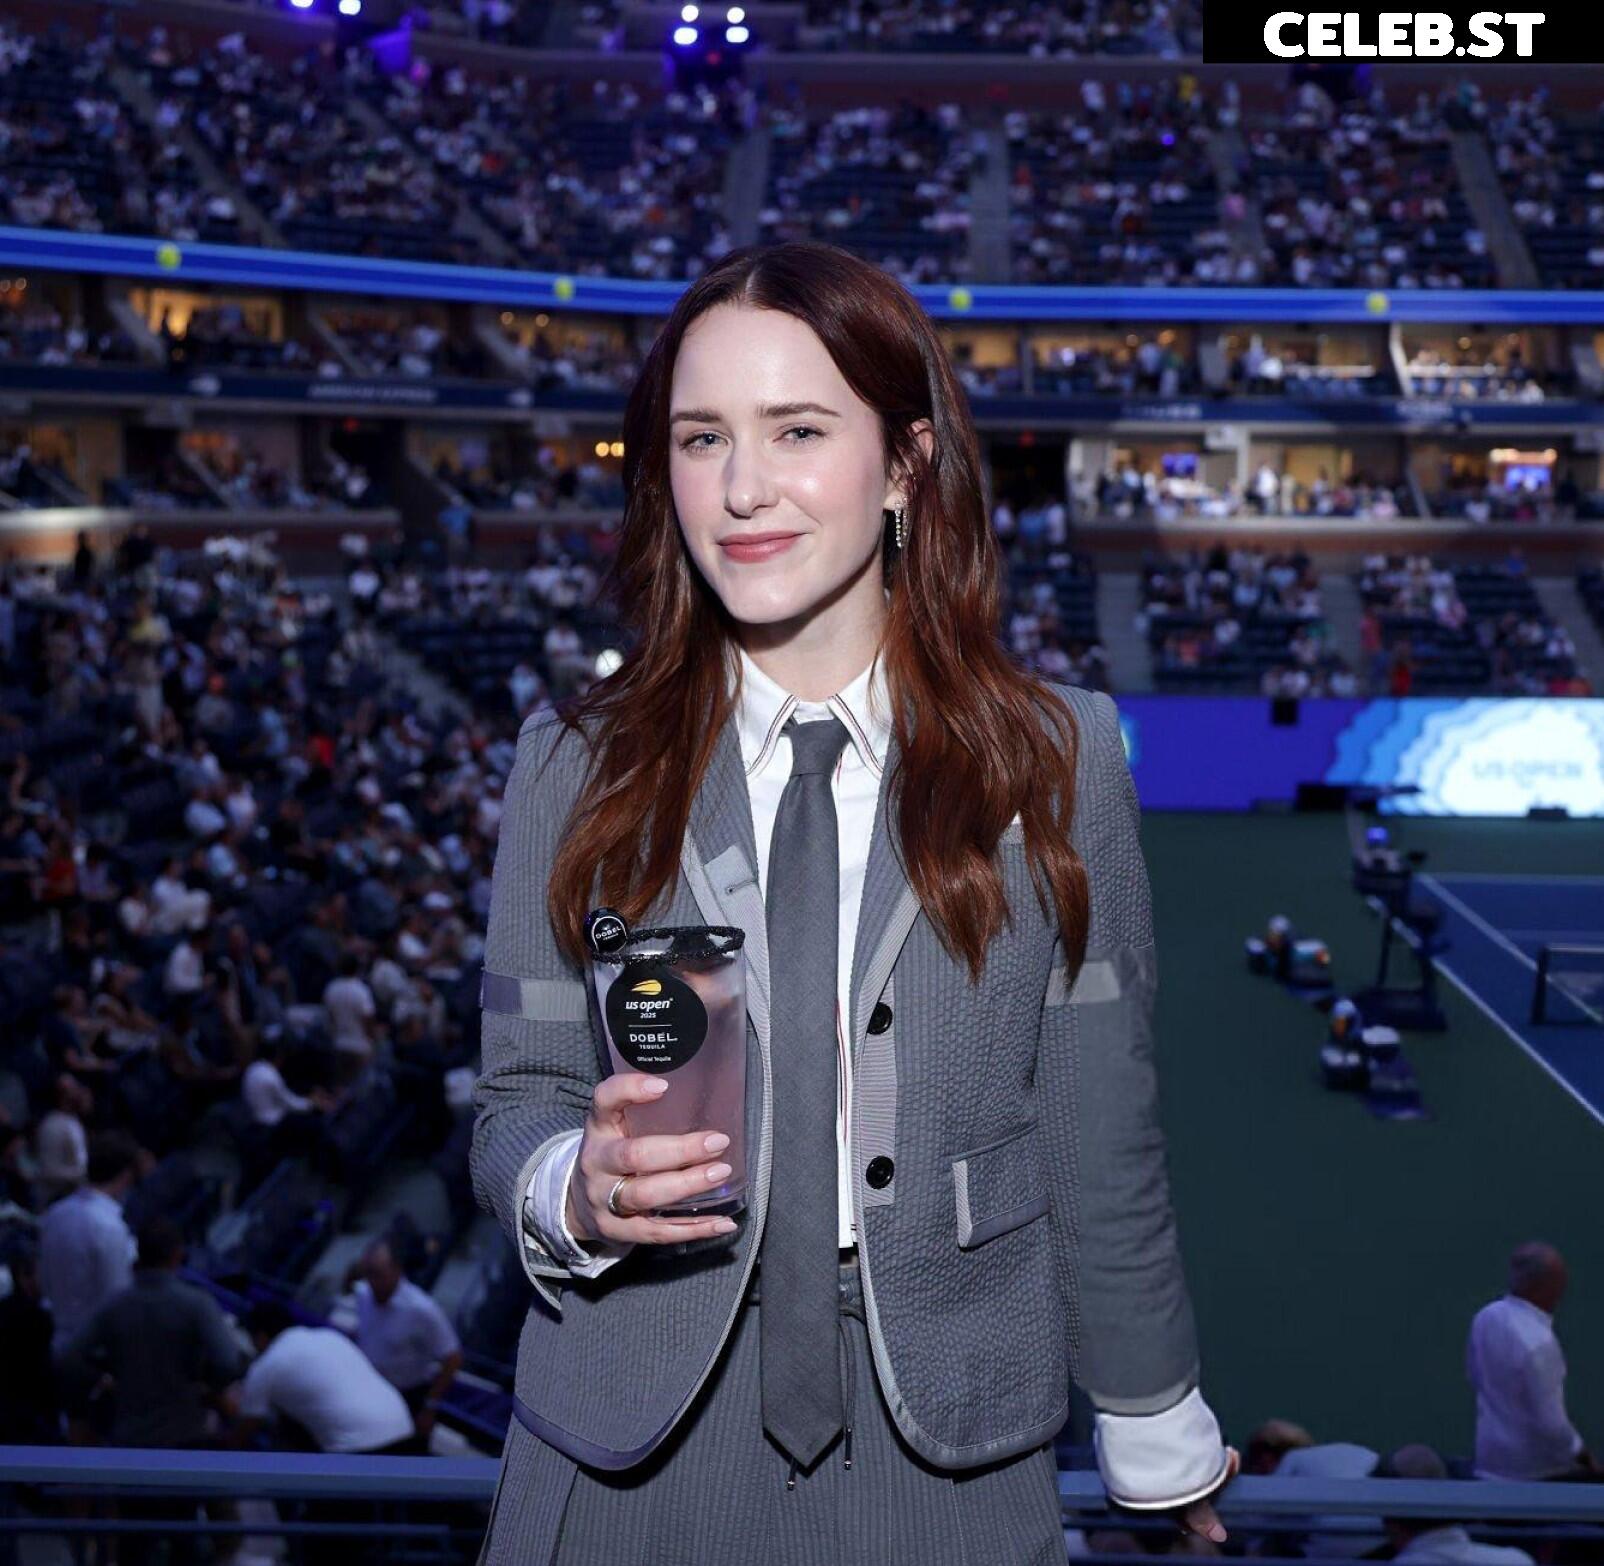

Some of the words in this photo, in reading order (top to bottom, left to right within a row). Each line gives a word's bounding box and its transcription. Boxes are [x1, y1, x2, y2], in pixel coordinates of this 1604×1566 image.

[595, 926, 621, 939] DOBEL
[625, 1000, 638, 1010] us
[639, 999, 670, 1012] open
